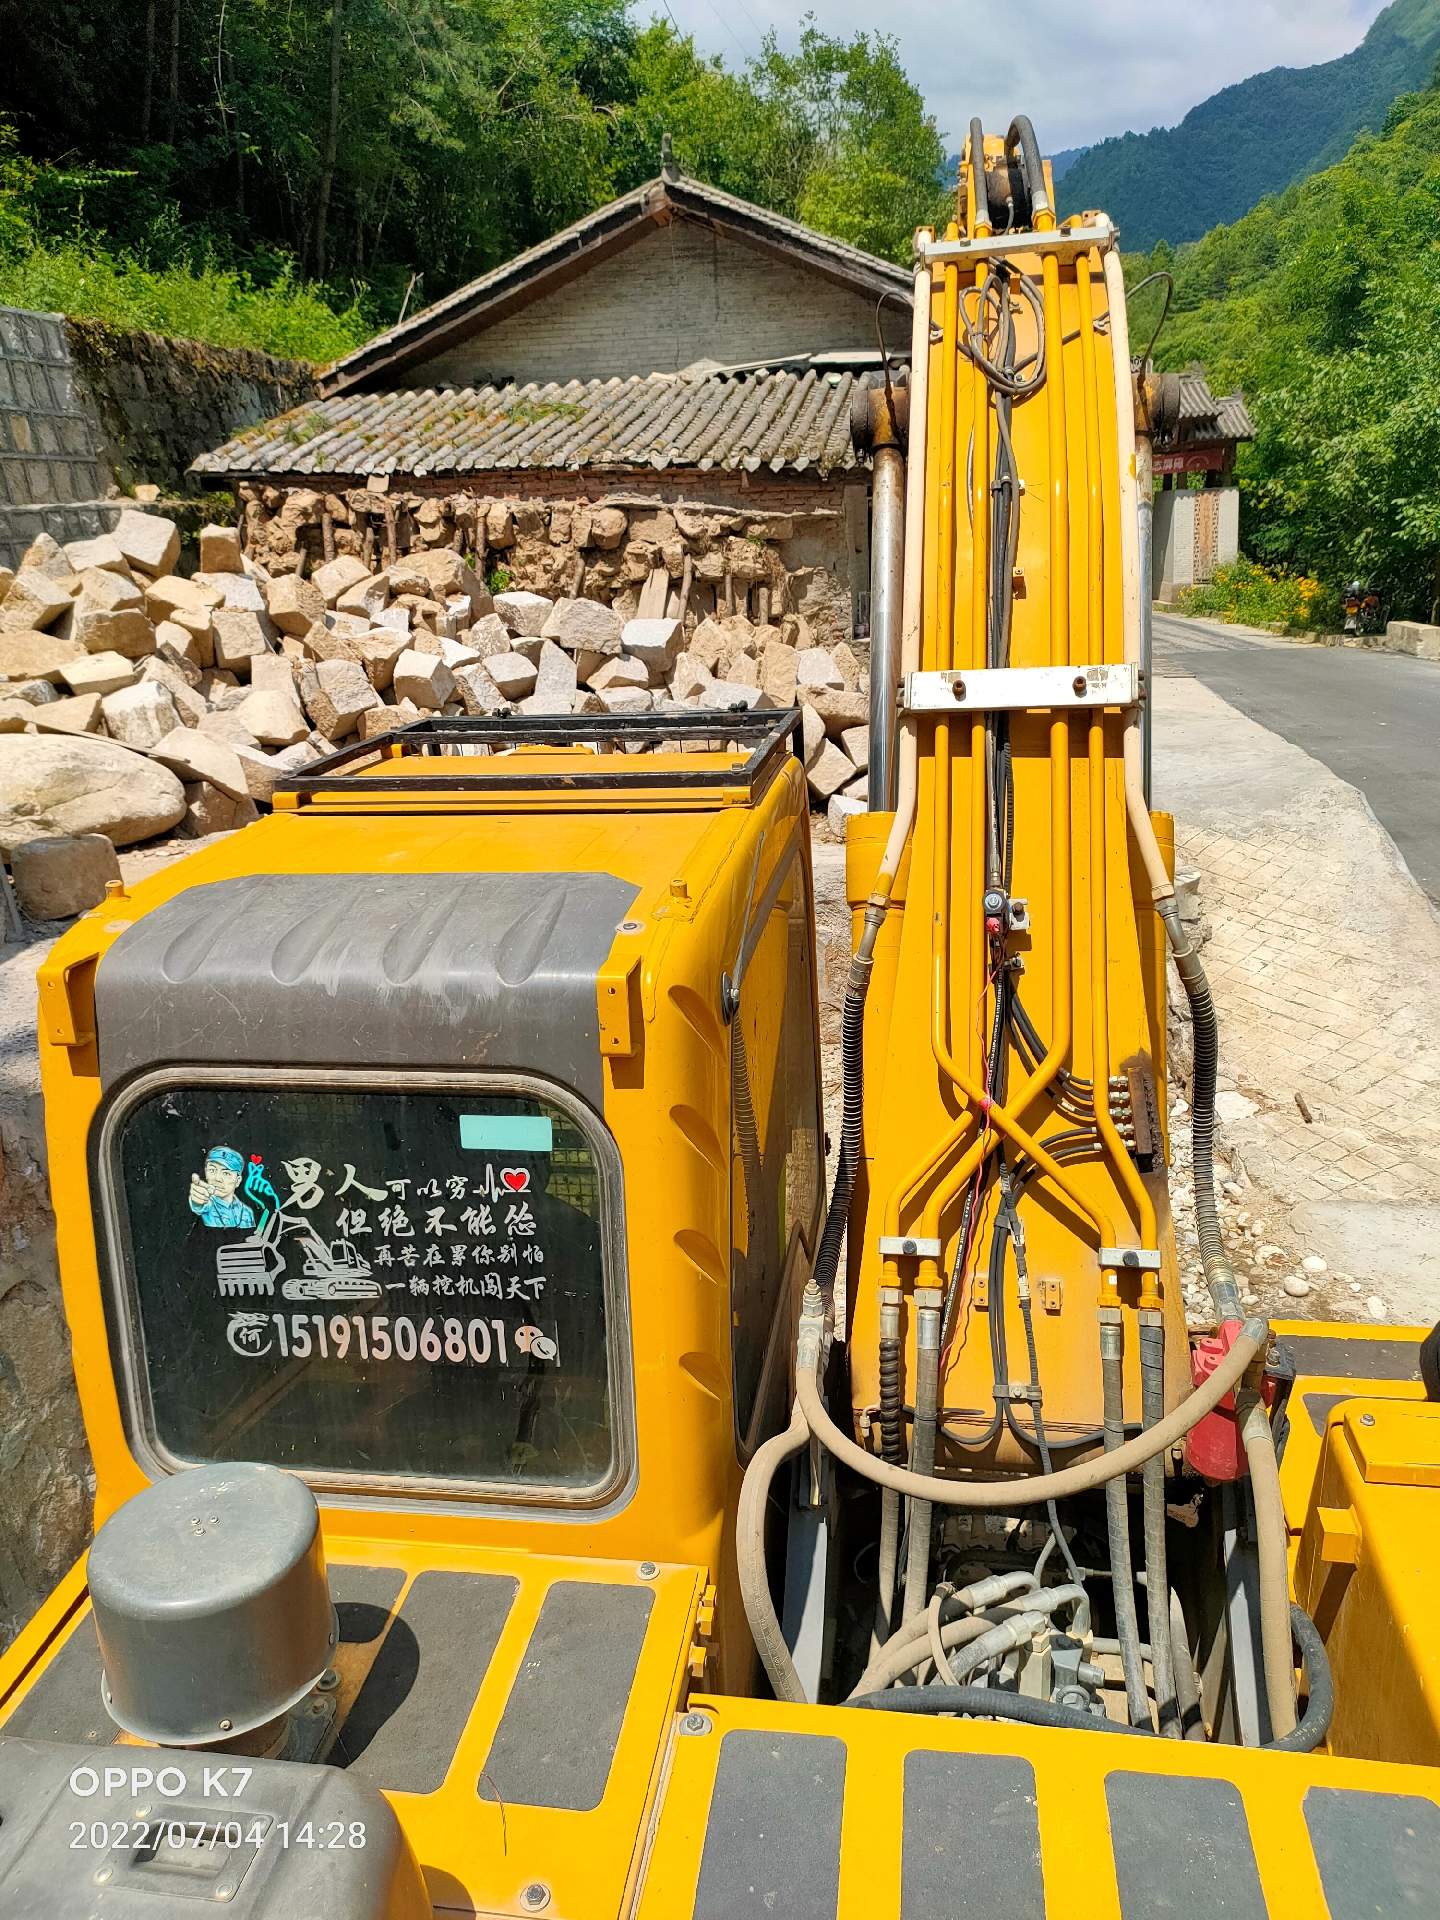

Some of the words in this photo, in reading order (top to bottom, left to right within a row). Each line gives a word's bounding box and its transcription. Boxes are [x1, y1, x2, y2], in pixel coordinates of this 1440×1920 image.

[281, 1157, 469, 1210] 男人可以穷
[335, 1200, 537, 1238] 但绝不能怂
[373, 1242, 545, 1268] 再苦在累你别怕
[384, 1271, 548, 1301] 一辆挖机闯天下
[272, 1313, 507, 1364] 15191506801
